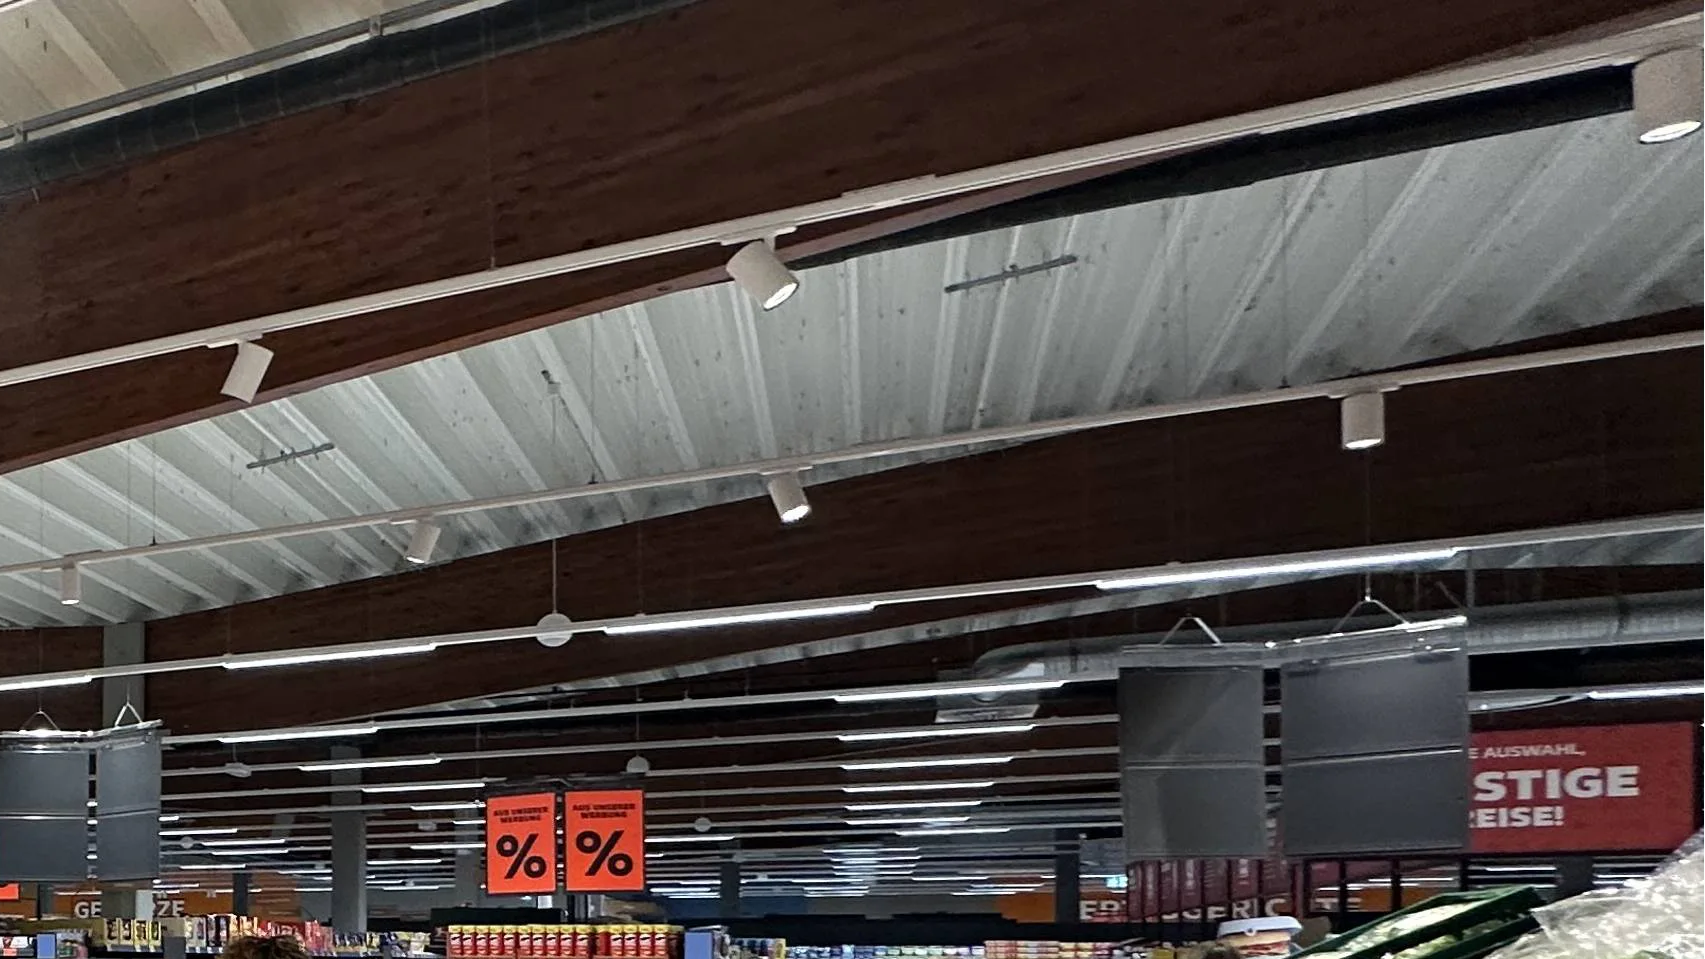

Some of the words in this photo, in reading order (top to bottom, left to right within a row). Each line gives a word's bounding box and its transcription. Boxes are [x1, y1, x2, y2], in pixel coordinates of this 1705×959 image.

[1472, 765, 1640, 802] STIGE
[1468, 806, 1564, 829] EISE!
[496, 833, 547, 879] %
[576, 830, 633, 876] %
